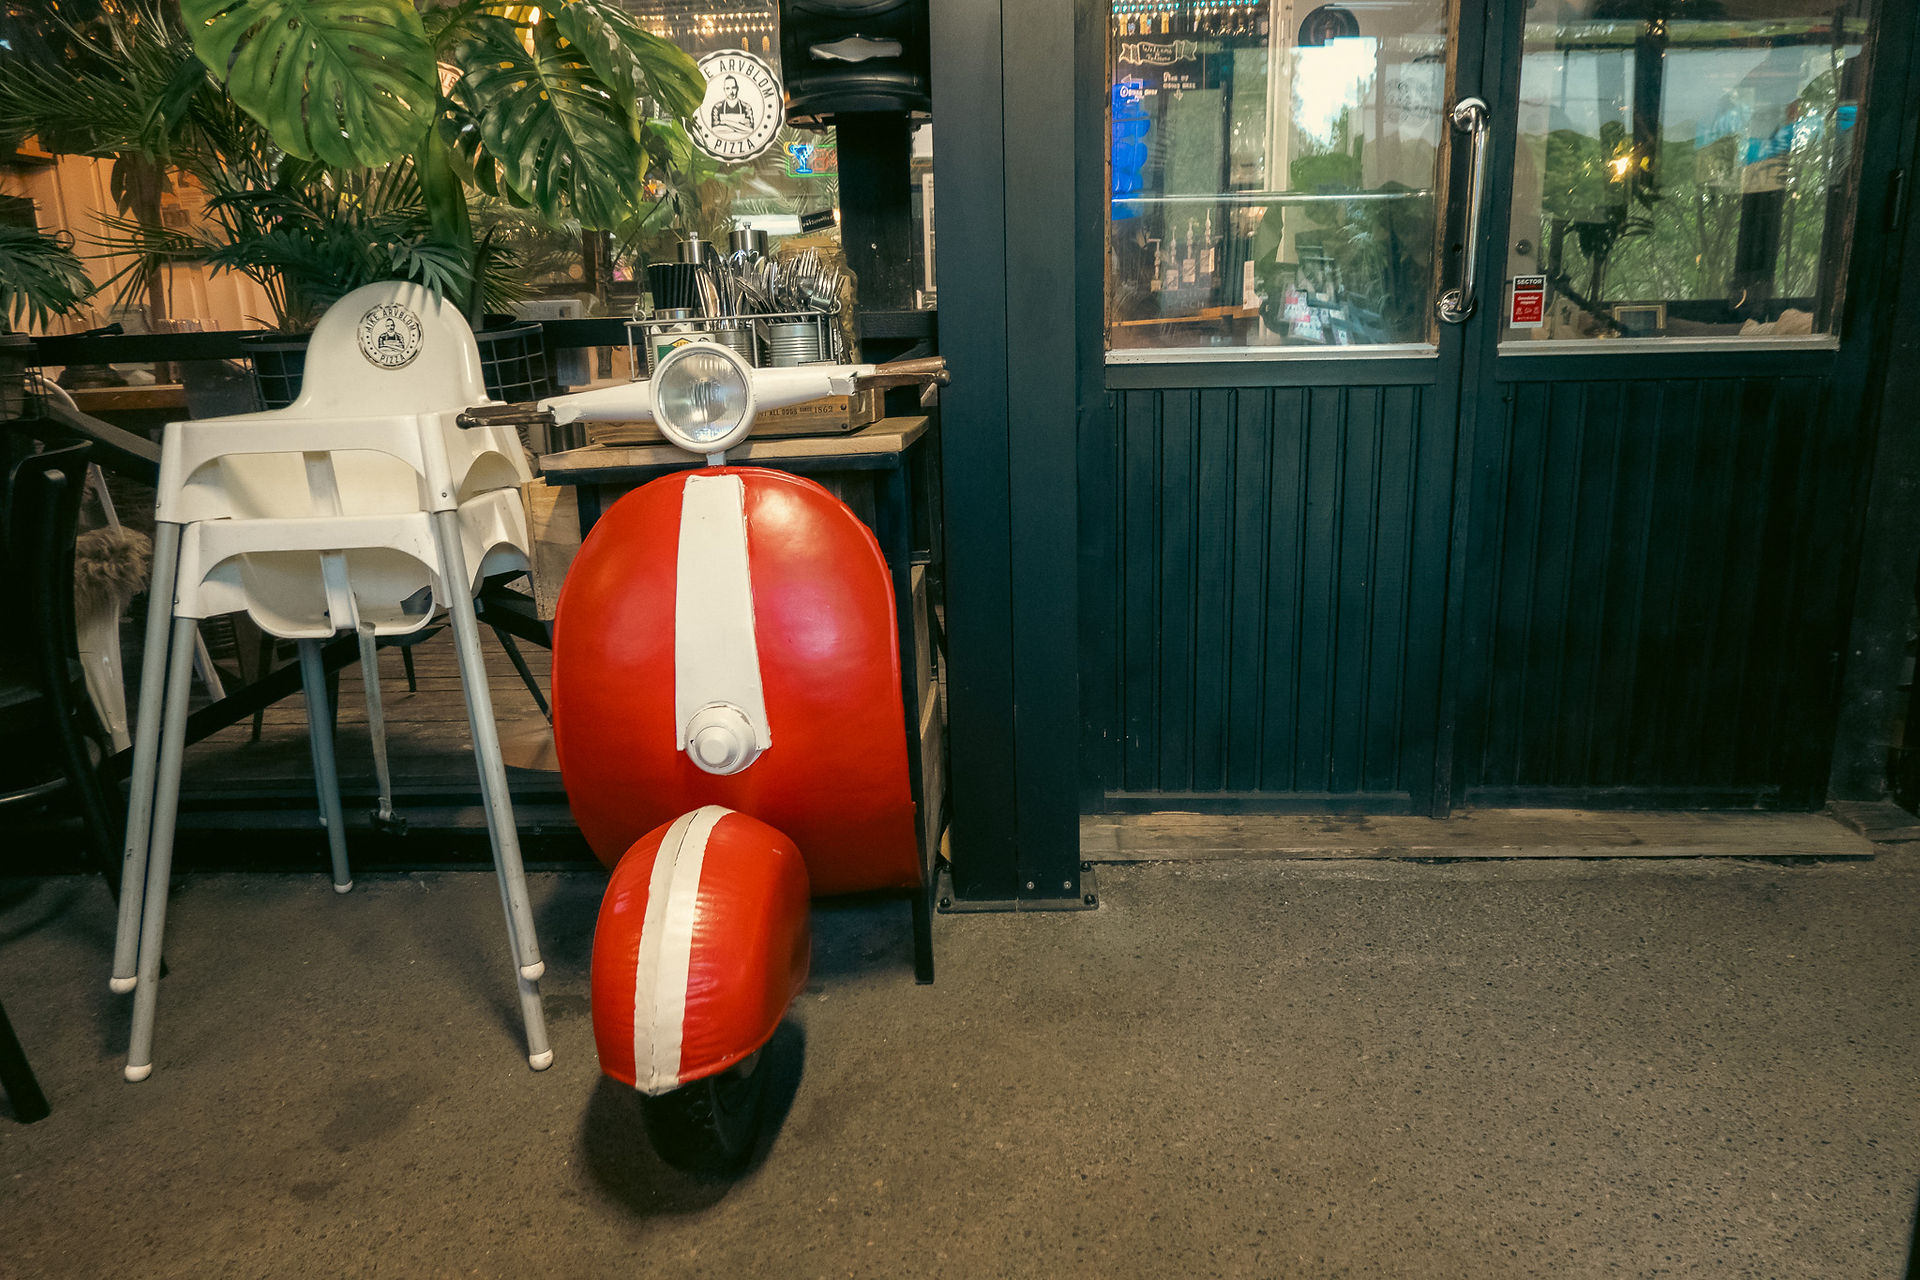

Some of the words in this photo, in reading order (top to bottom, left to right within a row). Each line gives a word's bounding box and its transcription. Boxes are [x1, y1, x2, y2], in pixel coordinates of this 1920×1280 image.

[720, 59, 774, 99] ARVBLOM
[714, 139, 756, 154] PIZZA
[365, 313, 379, 333] MIKE
[383, 308, 416, 331] ARVBLOM
[380, 354, 406, 363] PIZZA
[814, 405, 833, 414] 1862
